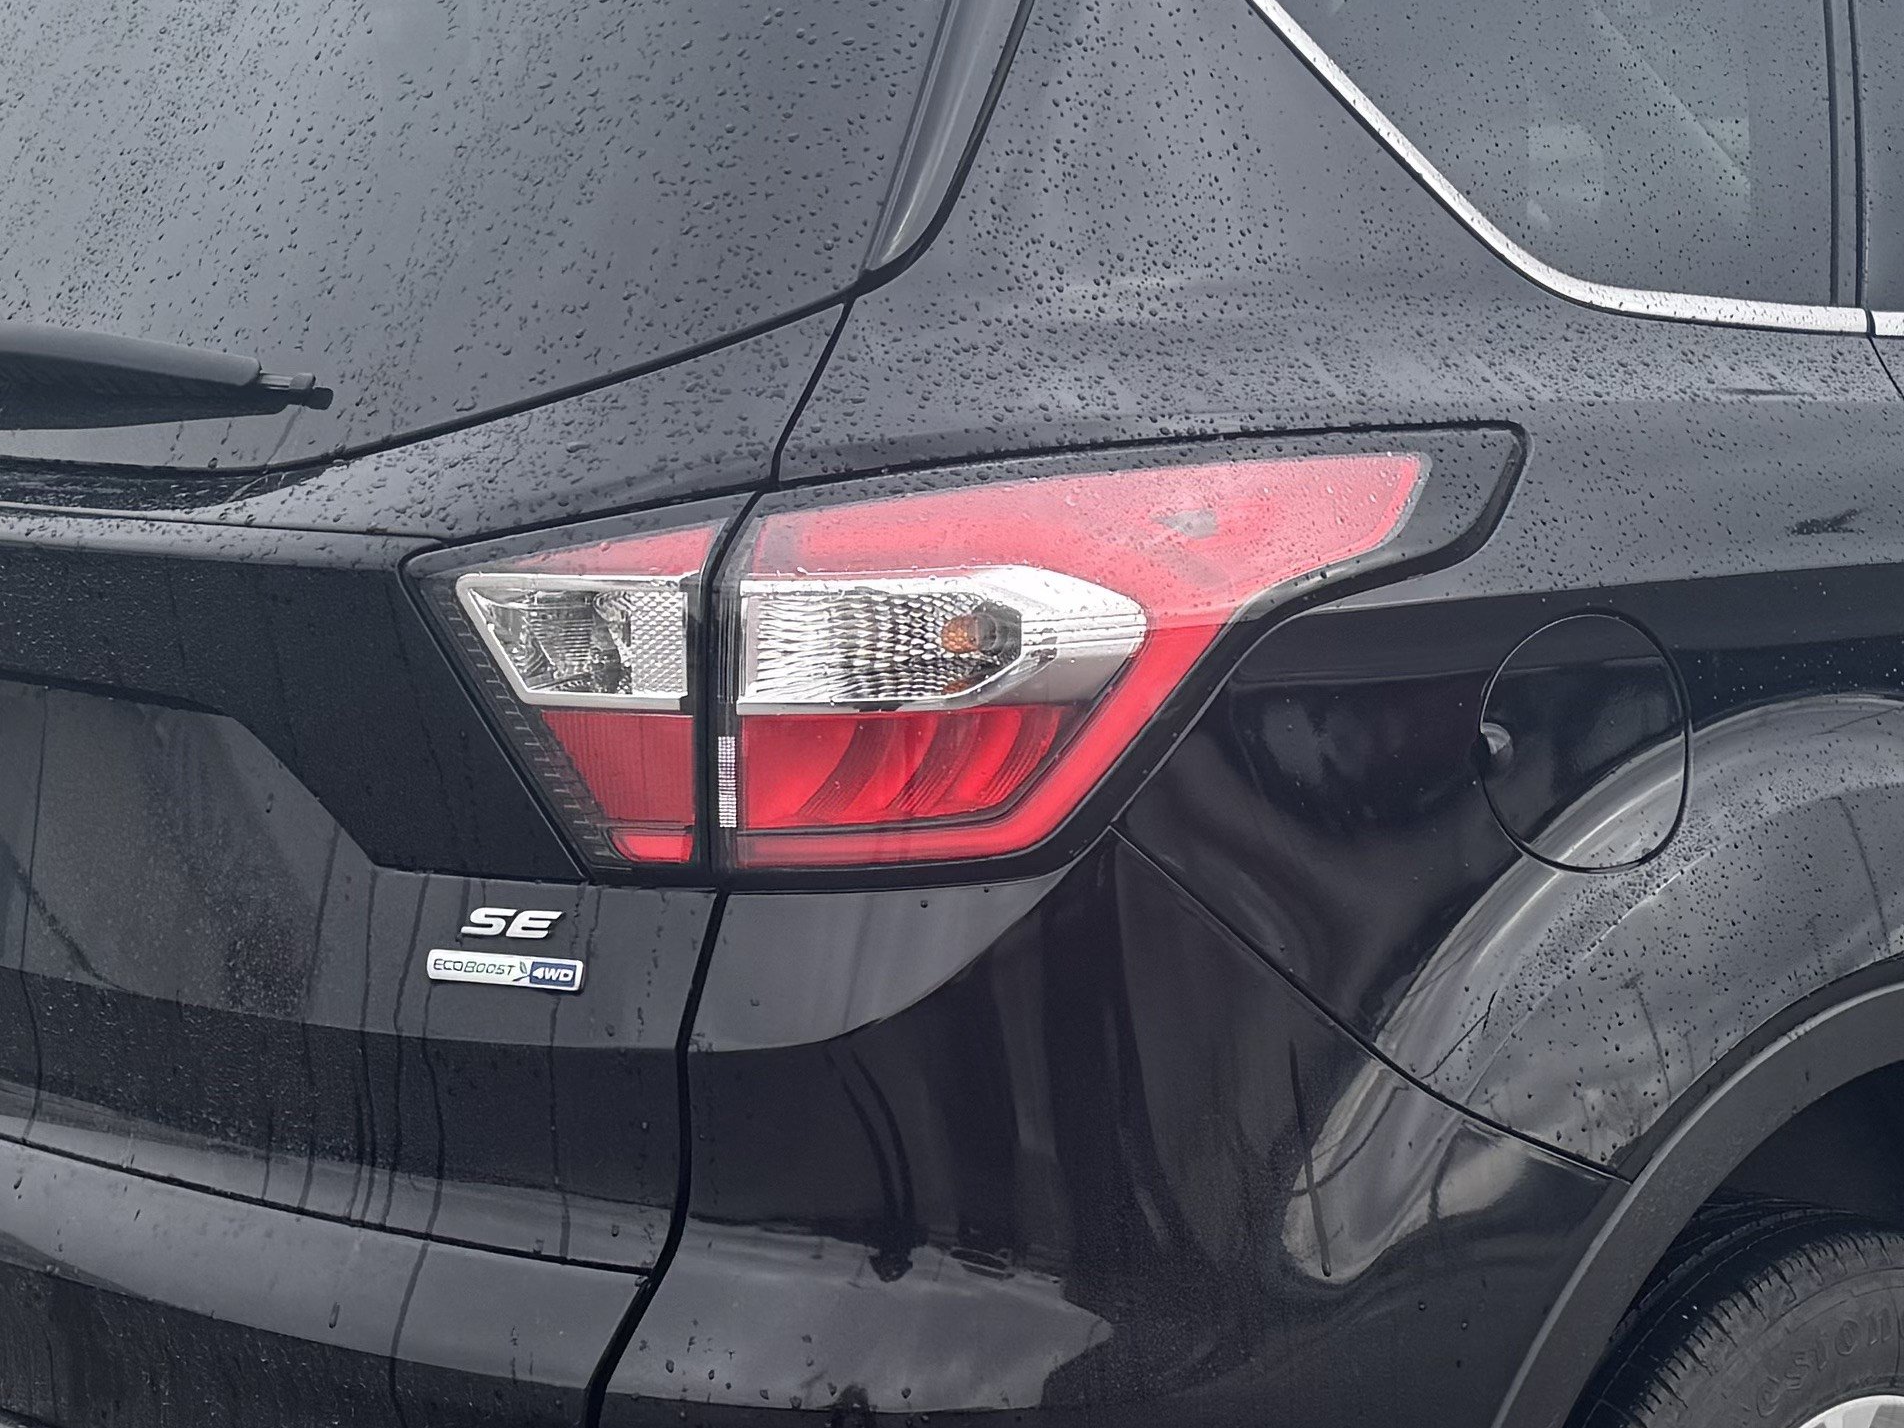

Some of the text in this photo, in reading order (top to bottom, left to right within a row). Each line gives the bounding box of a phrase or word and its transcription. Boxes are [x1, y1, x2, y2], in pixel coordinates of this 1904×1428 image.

[460, 906, 563, 939] SE
[432, 958, 576, 983] ECOBOOST 4WD
